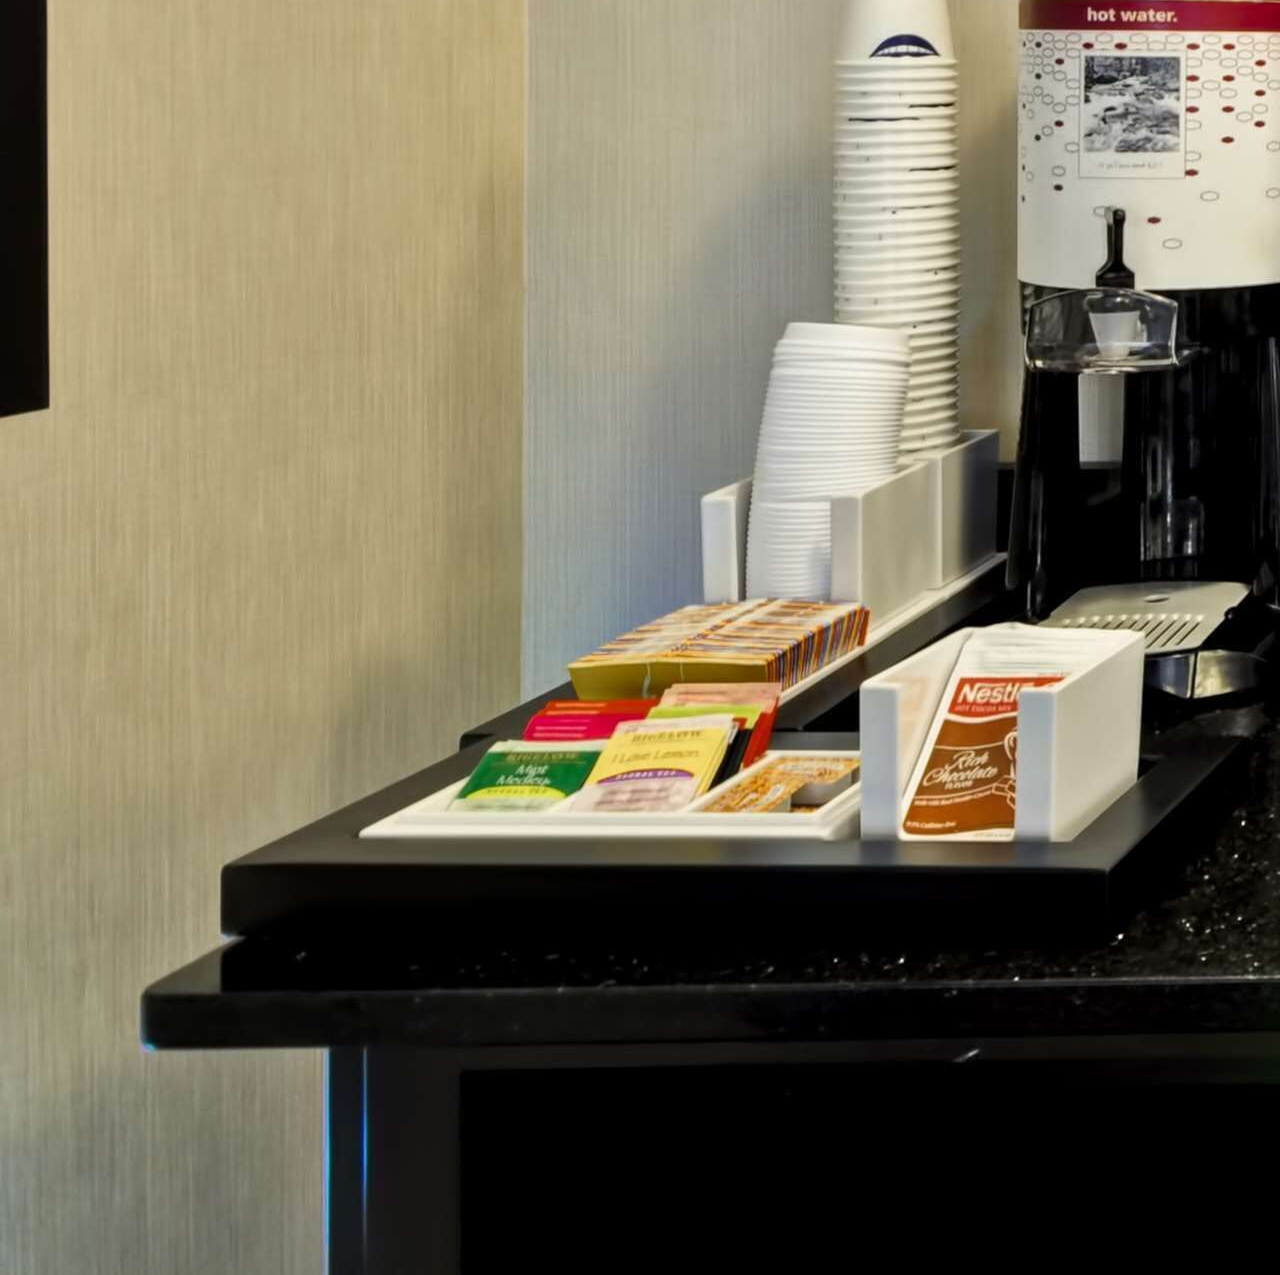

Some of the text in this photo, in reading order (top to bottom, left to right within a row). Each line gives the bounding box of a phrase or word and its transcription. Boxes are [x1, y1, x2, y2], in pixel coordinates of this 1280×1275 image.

[1086, 6, 1178, 23] hot water.
[957, 682, 1020, 704] Nestl
[947, 750, 990, 771] Rich
[923, 763, 999, 787] Chocolate
